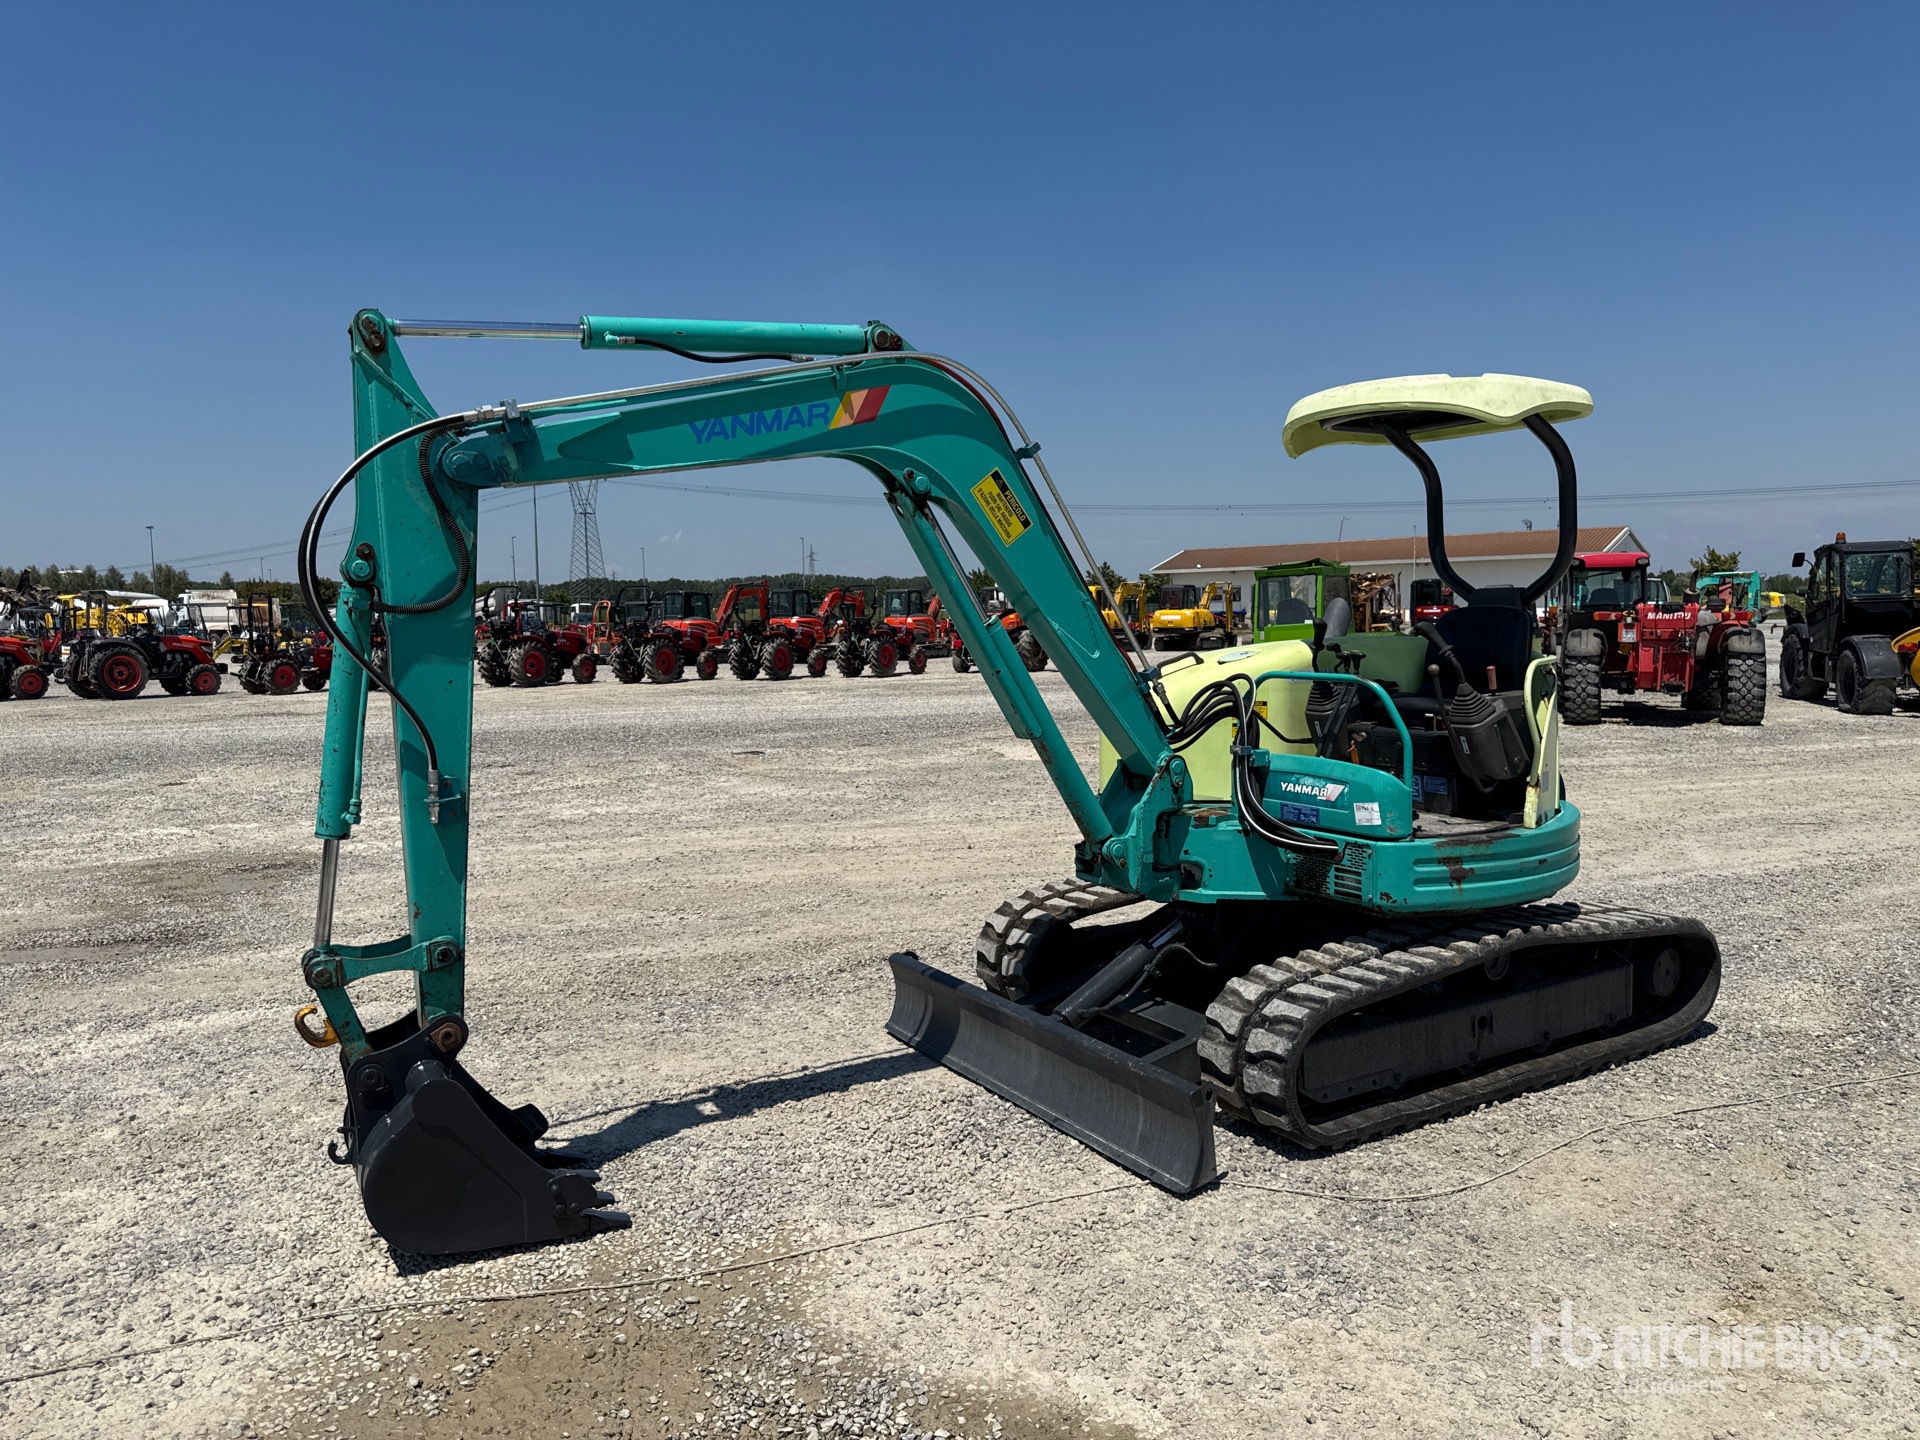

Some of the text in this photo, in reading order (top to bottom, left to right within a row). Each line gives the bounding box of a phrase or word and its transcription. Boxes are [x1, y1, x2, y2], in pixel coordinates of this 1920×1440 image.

[688, 402, 830, 444] YANMAR
[1004, 490, 1026, 522] PERICOLO
[1647, 611, 1692, 620] MANITOU
[1280, 781, 1328, 797] YANMAR
